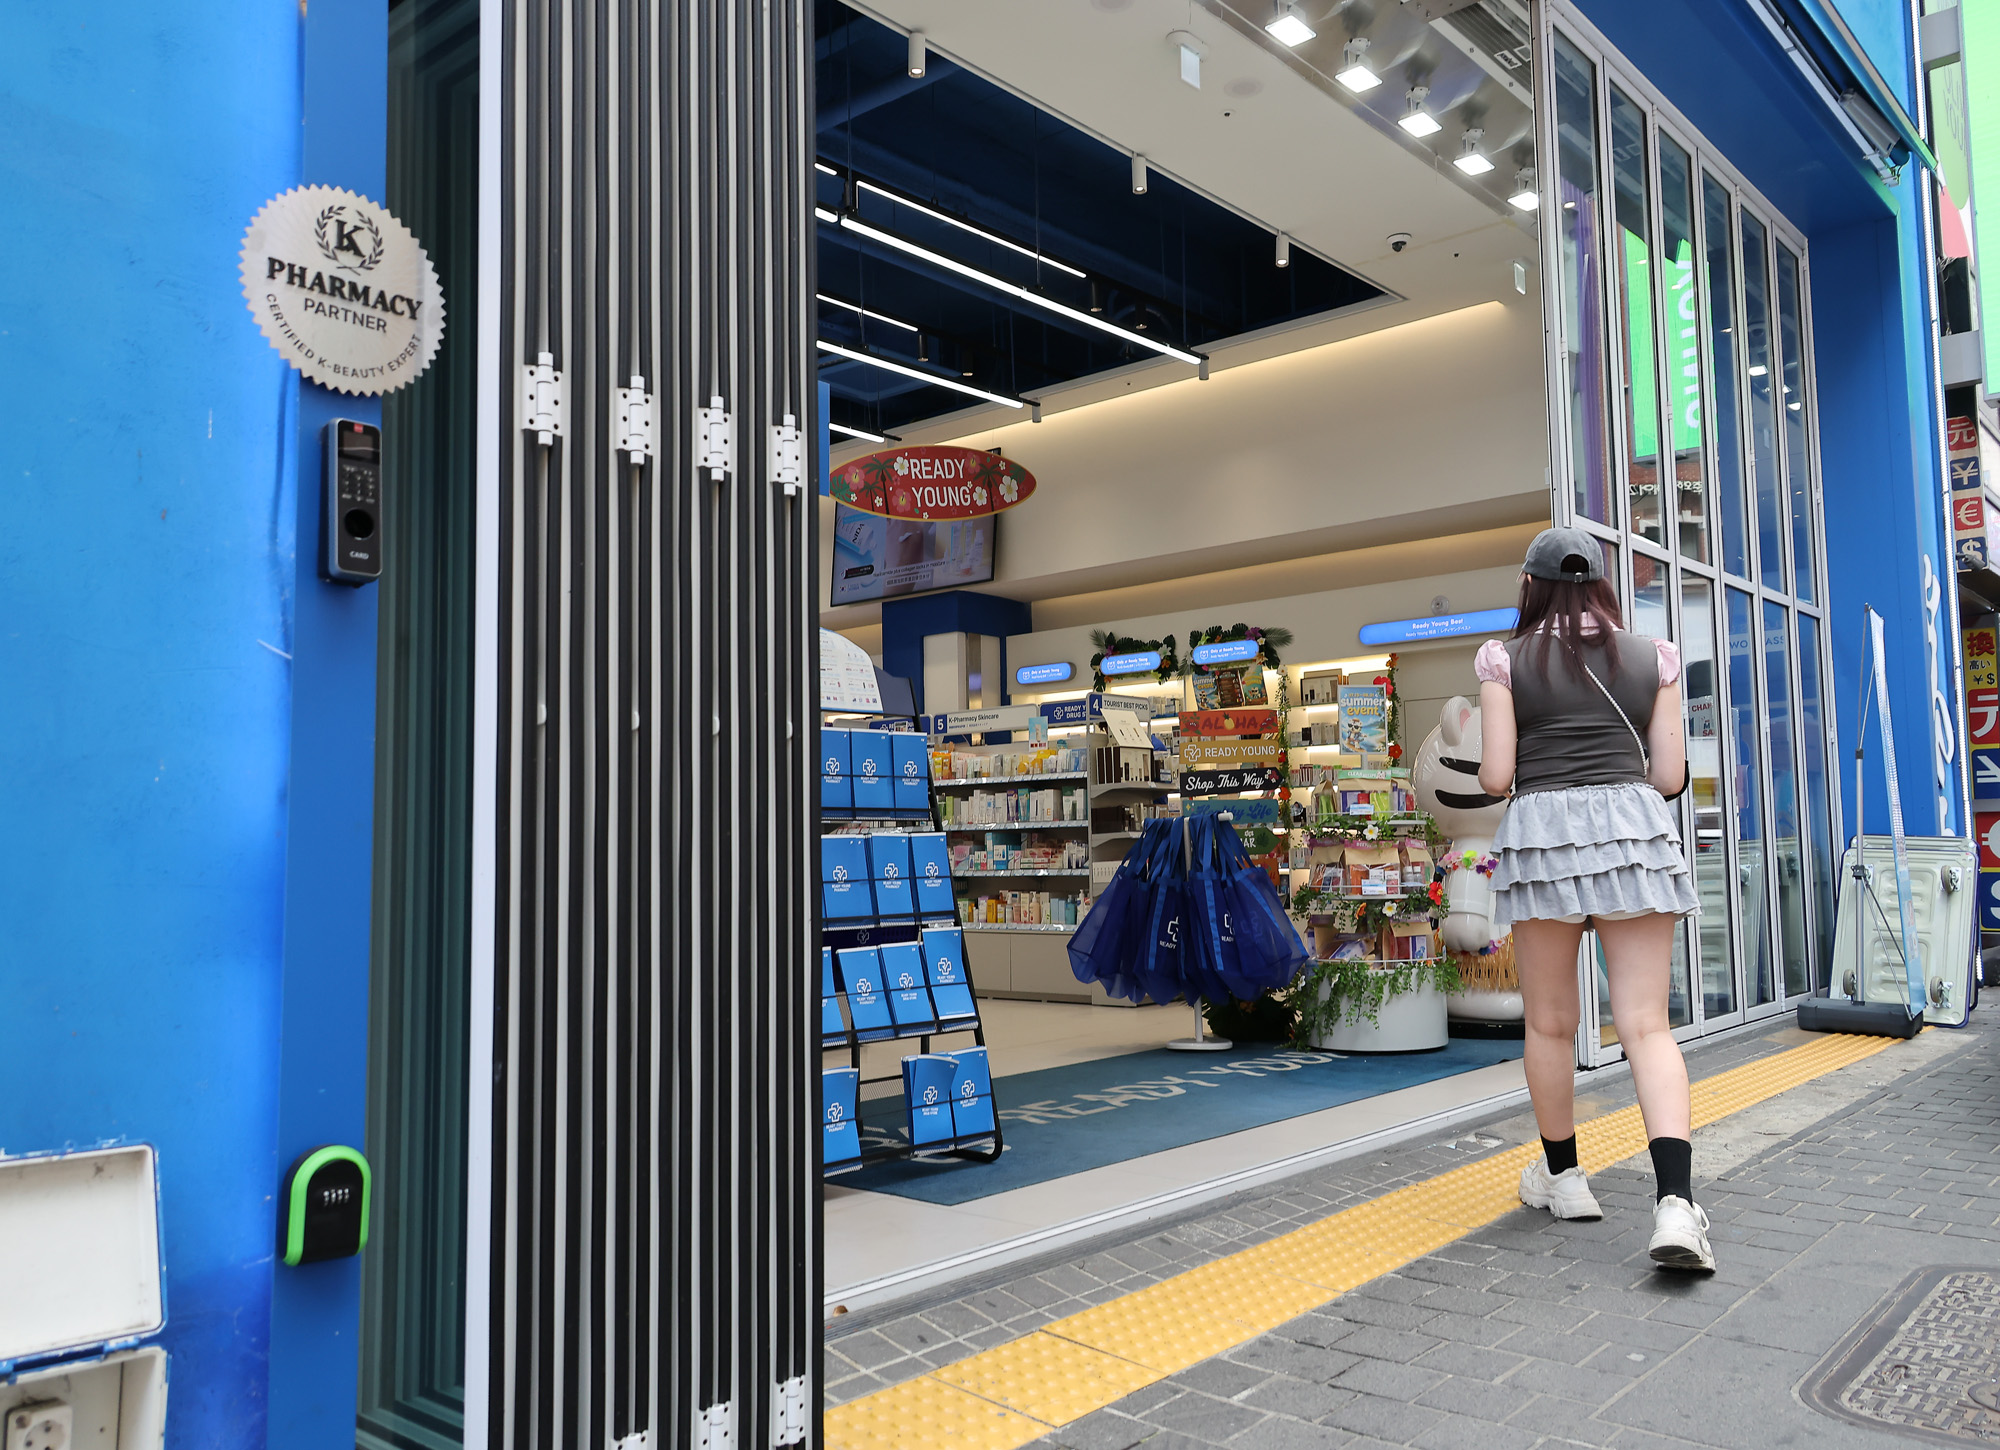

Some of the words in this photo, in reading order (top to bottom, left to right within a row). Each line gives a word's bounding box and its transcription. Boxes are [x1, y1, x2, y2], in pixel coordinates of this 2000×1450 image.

[334, 219, 364, 258] K
[266, 257, 423, 320] PHARMACY
[304, 298, 387, 334] PARTNER
[266, 293, 315, 360] CERTIFIED
[318, 356, 386, 379] K-BEAUTY
[388, 333, 421, 372] EXPERT
[1948, 422, 1976, 446] 元
[910, 458, 966, 480] READY
[912, 486, 972, 508] YOUNG
[1957, 500, 1980, 526] €
[1412, 622, 1430, 630] Ready
[1093, 698, 1100, 712] 4
[1104, 700, 1123, 708] TOURIST
[1340, 698, 1384, 707] summer
[1346, 706, 1380, 716] event
[938, 718, 944, 730] 5
[1205, 747, 1238, 758] READY
[1240, 746, 1276, 756] YOUNG
[1186, 776, 1214, 792] Shop
[1218, 774, 1239, 788] This
[1242, 772, 1264, 788] Way
[1160, 940, 1176, 950] READY
